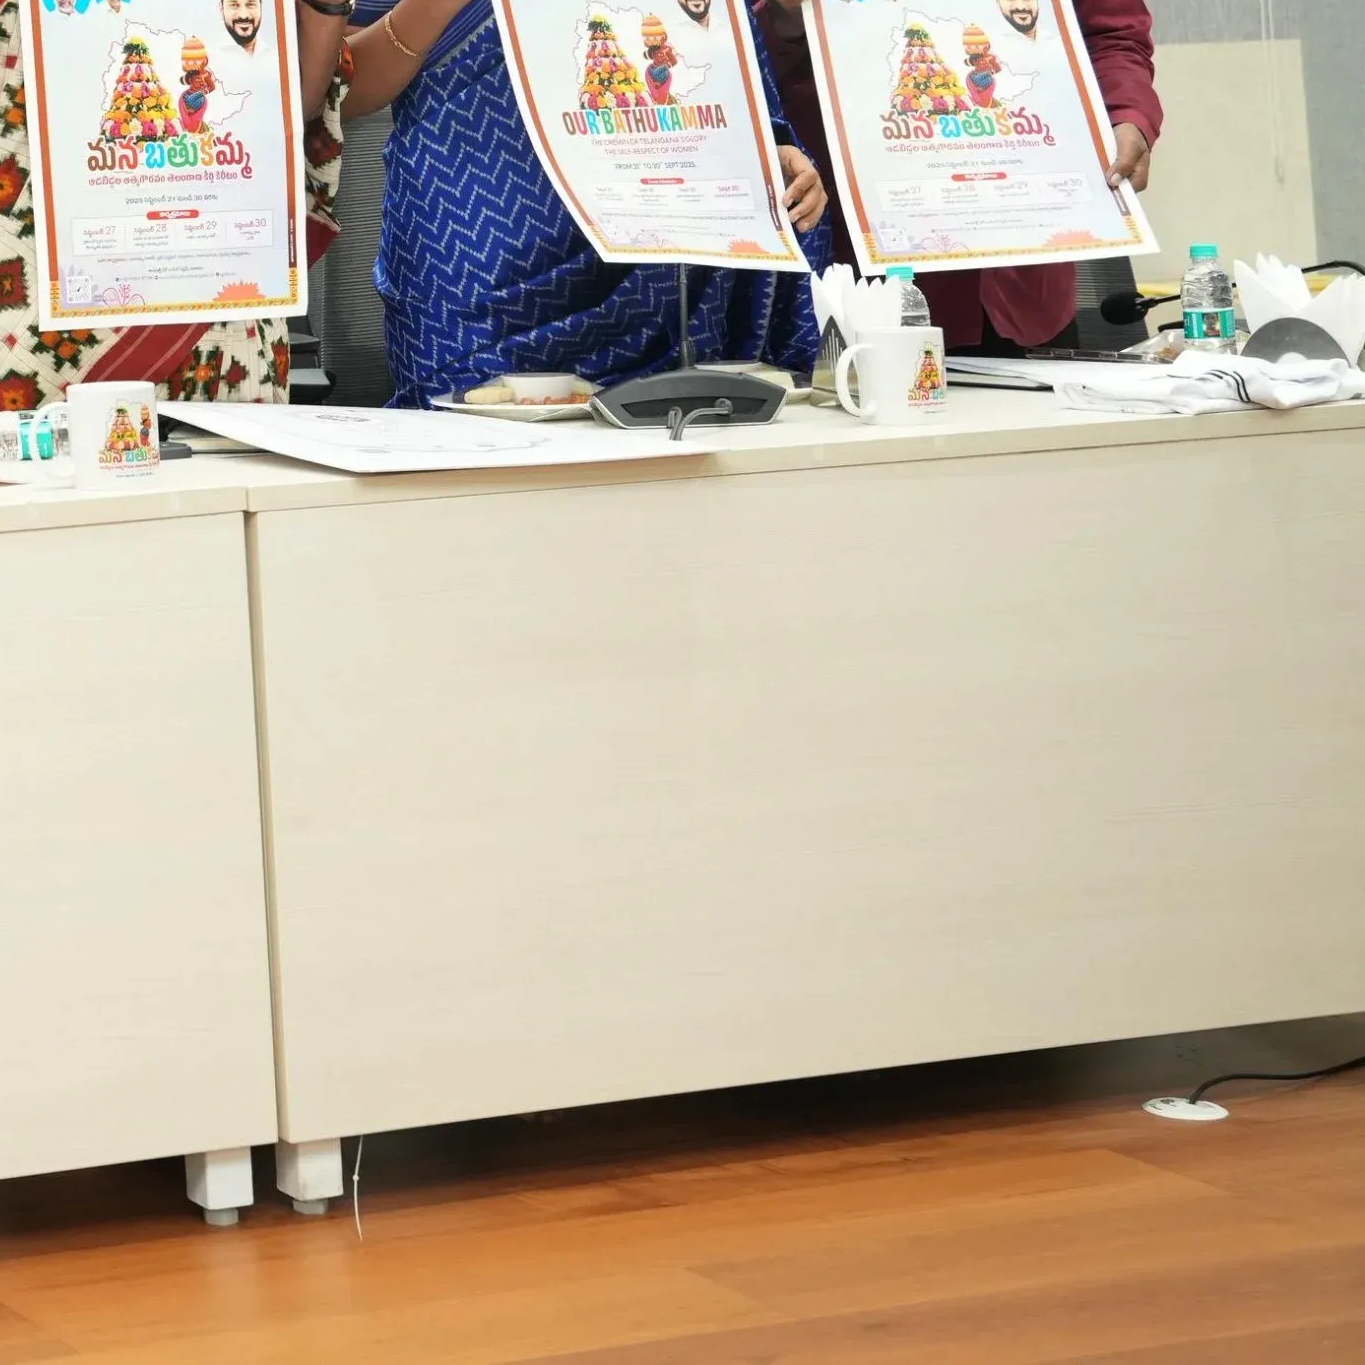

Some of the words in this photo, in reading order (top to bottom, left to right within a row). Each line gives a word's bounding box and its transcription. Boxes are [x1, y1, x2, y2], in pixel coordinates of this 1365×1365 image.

[562, 110, 599, 136] OUR
[601, 104, 727, 134] BATHUKAMMA
[879, 109, 934, 140] మన
[938, 106, 1056, 146] బతుకమ్మ
[87, 136, 138, 171] మన
[144, 131, 253, 179] బతుకమ్మ
[206, 220, 217, 230] 29
[255, 218, 267, 227] 30
[105, 225, 116, 235] 27
[156, 223, 167, 233] 28
